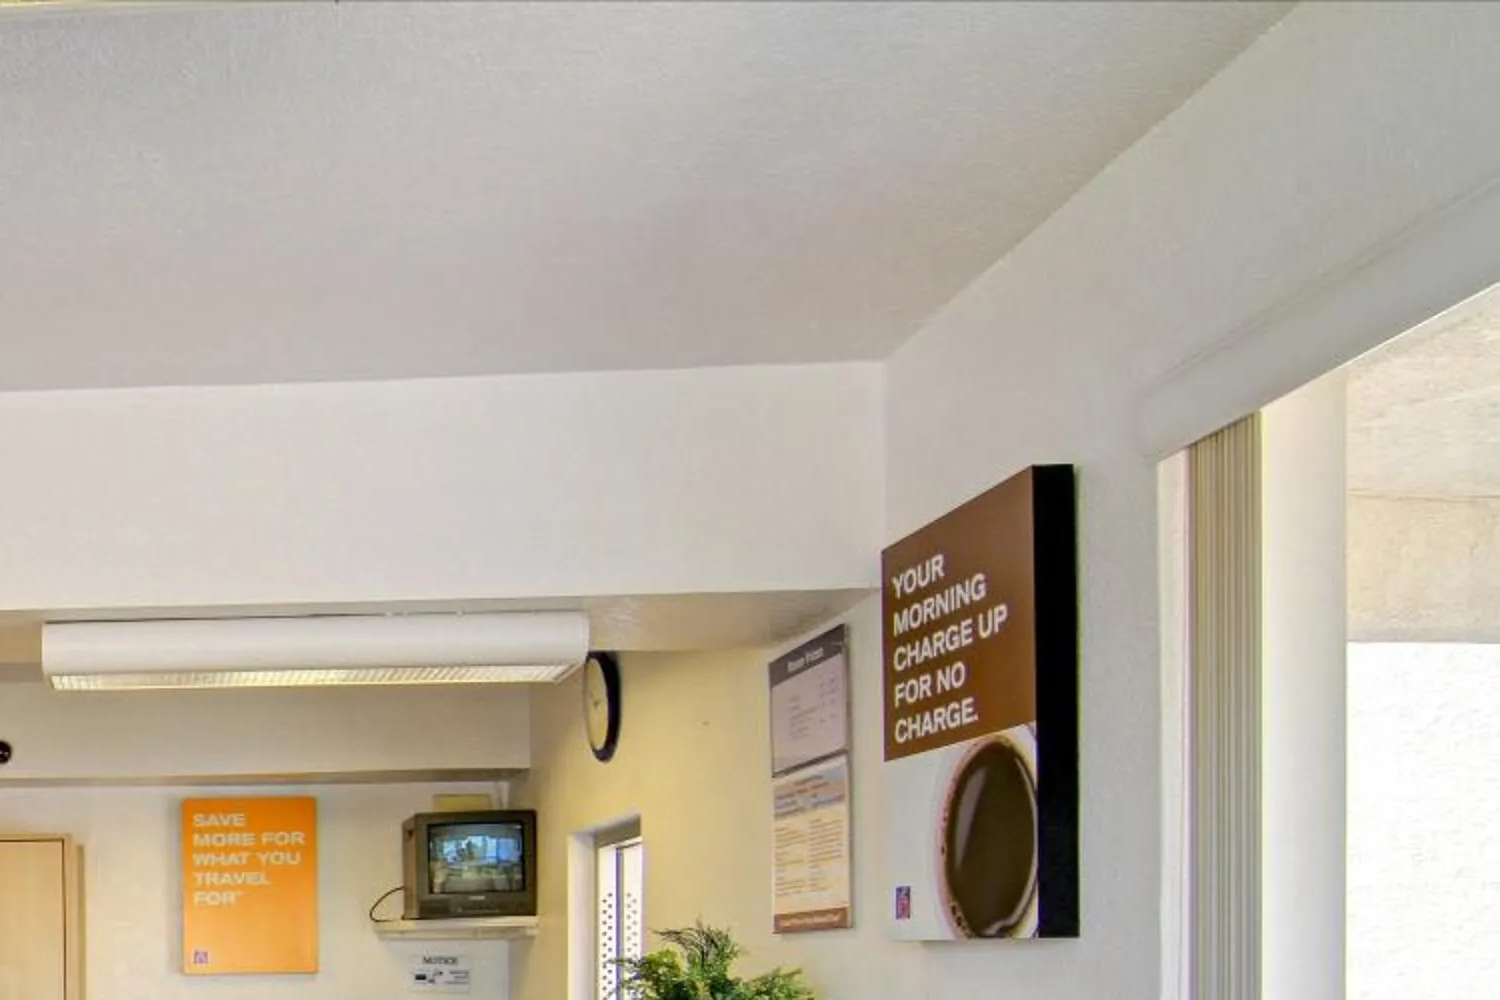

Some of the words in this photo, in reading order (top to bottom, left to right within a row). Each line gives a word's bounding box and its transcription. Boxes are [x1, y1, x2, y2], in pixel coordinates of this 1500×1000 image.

[892, 554, 945, 599] YOUR
[893, 573, 987, 637] MORNING
[893, 620, 973, 673] CHARGE
[978, 605, 1008, 639] UP
[894, 675, 933, 707] FOR
[936, 661, 966, 694] NO
[894, 697, 979, 744] CHARGE.
[193, 813, 245, 827] SAVE
[193, 833, 256, 848] MORE
[261, 831, 306, 845] FOR
[193, 852, 249, 866] WHAT
[257, 852, 301, 865] YOU
[194, 872, 269, 886] TRAVEL
